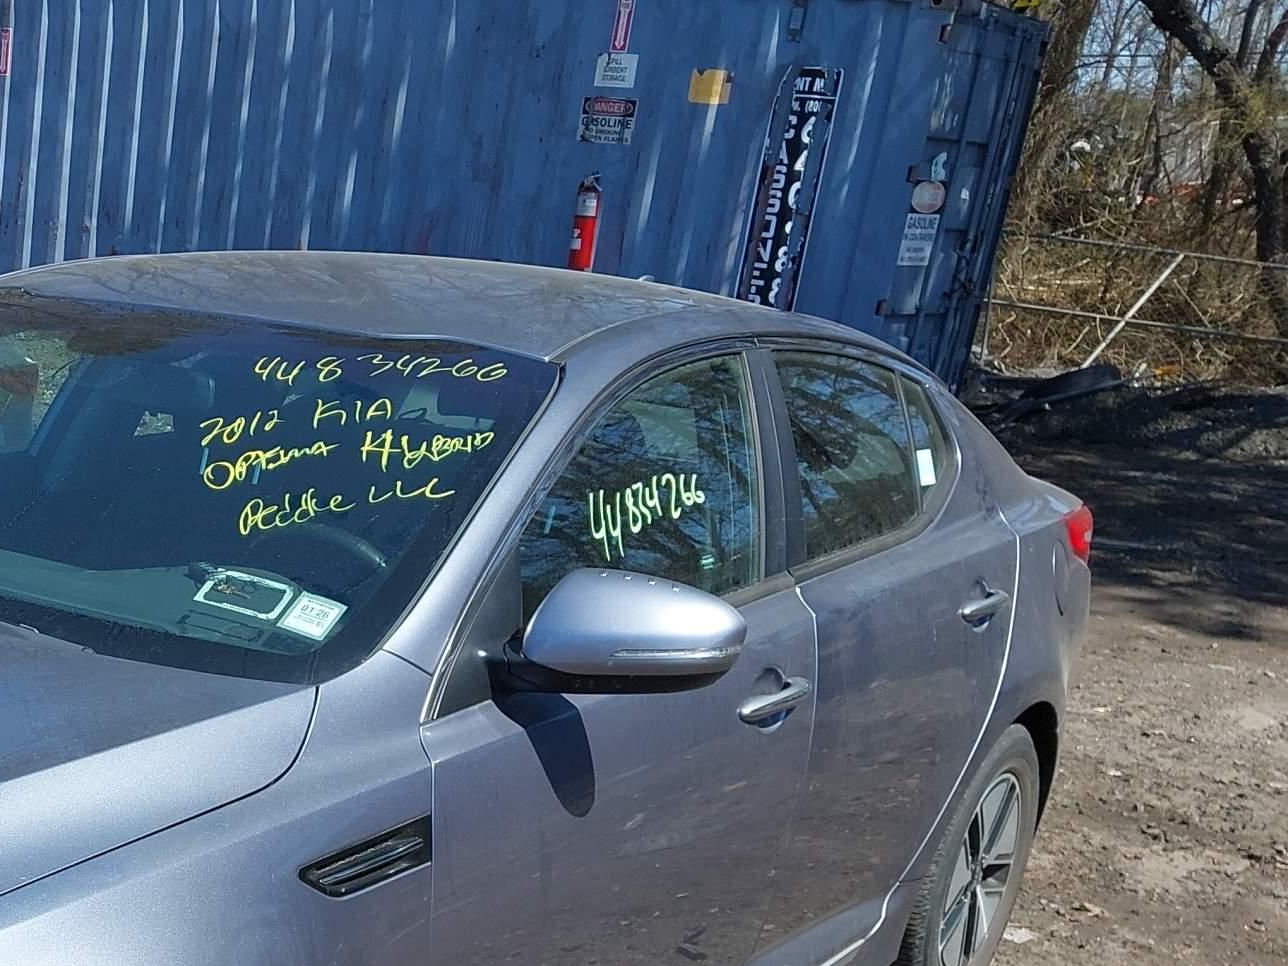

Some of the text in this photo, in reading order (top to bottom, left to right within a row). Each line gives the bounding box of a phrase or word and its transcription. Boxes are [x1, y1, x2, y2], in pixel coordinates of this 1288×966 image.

[581, 116, 633, 130] GSOLINE
[199, 398, 392, 446] 2012 KIA
[589, 473, 706, 562] 44834266
